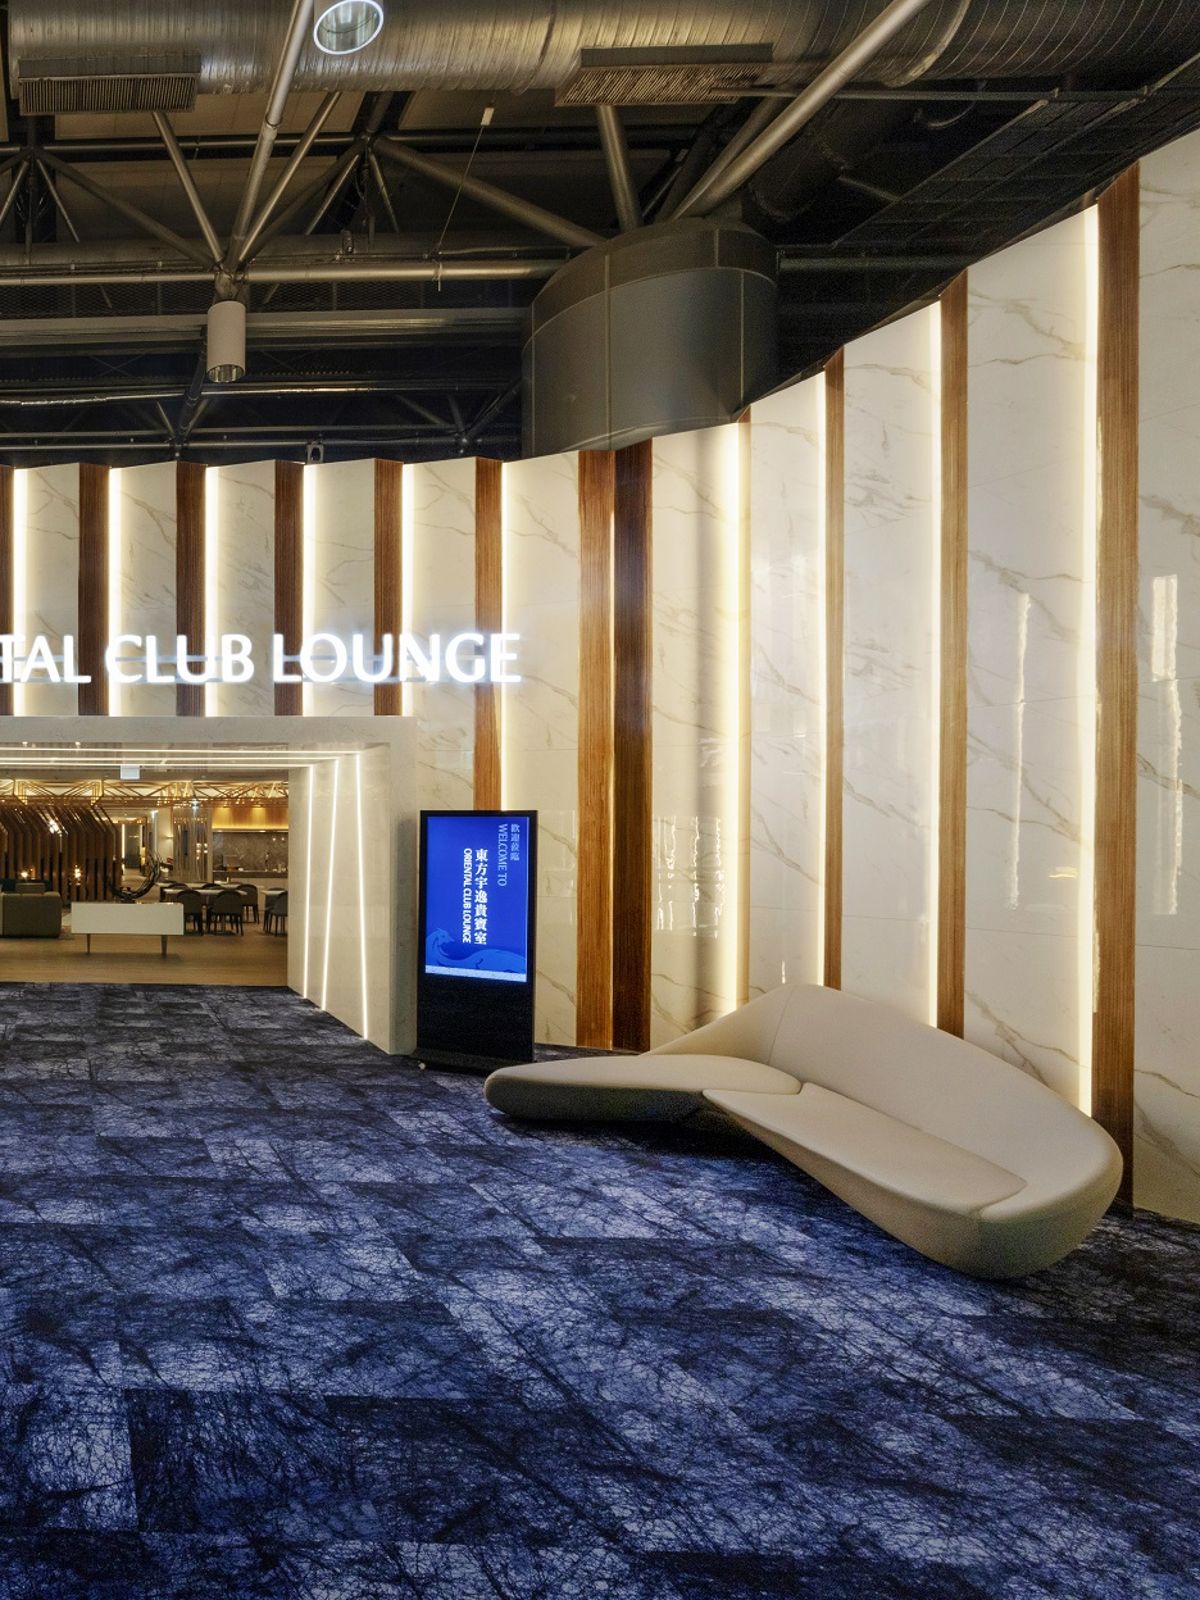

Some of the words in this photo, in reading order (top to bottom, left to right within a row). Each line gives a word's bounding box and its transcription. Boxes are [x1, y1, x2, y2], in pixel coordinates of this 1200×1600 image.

[105, 634, 255, 683] CLUB
[272, 633, 522, 683] LOUNGE
[498, 823, 508, 871] WELCOME
[463, 848, 472, 887] ORIENTAL
[497, 872, 507, 887] TO
[463, 888, 472, 909] CLUB
[462, 909, 472, 944] LOUNGE
